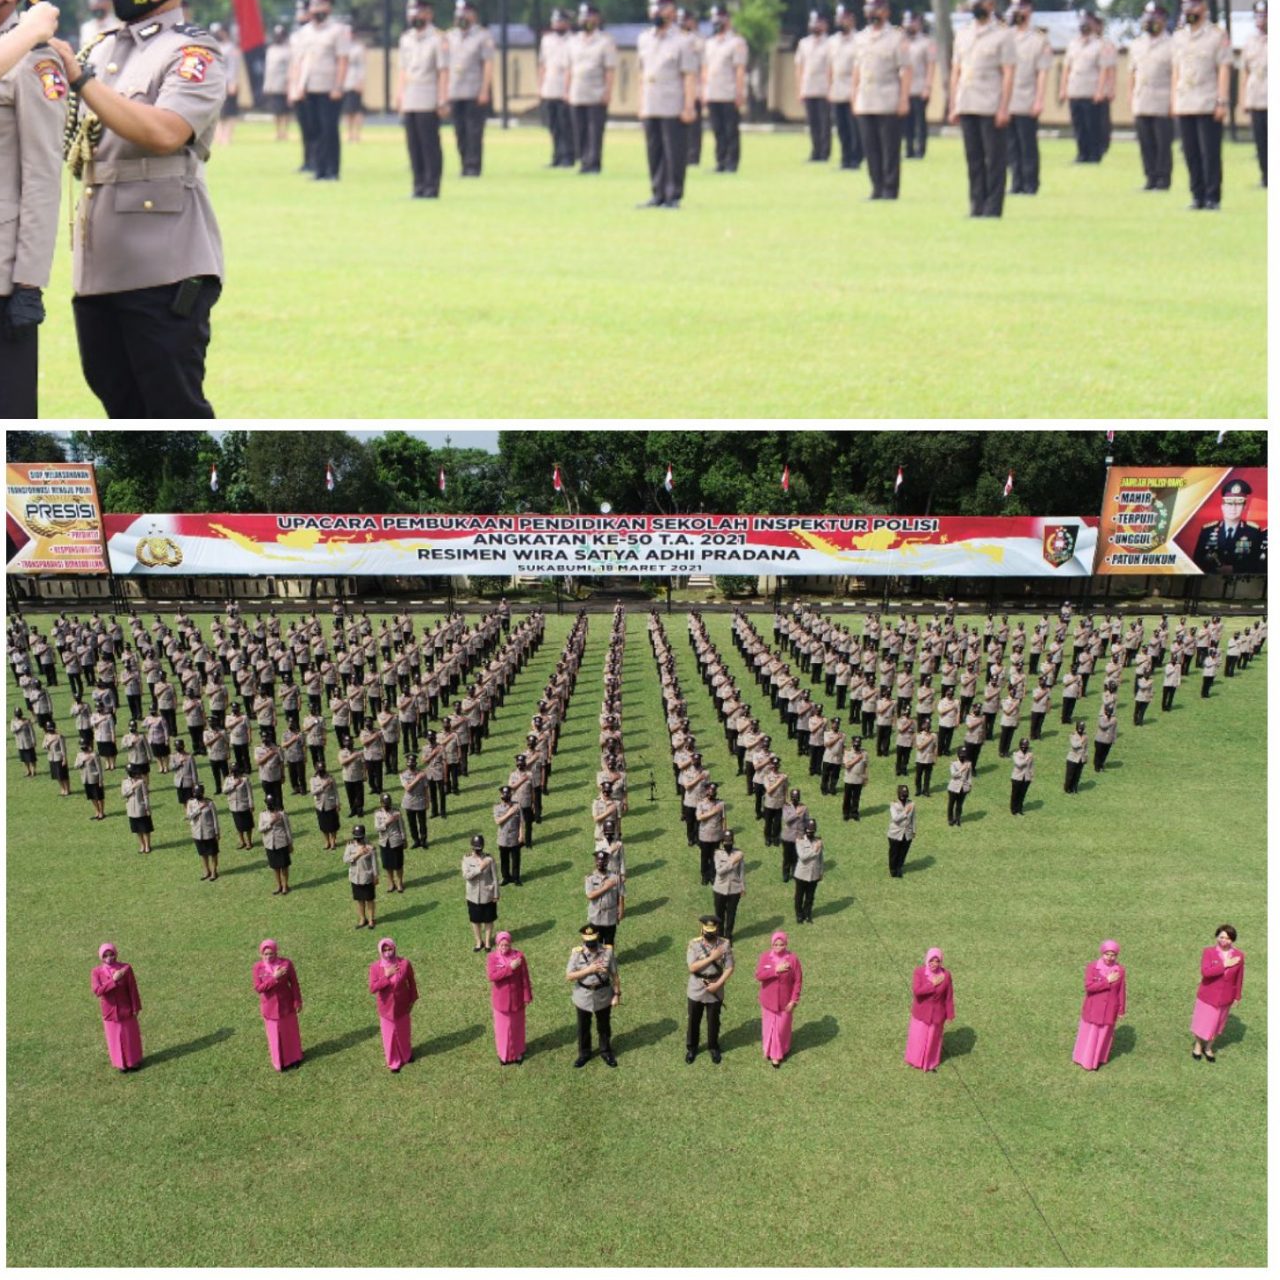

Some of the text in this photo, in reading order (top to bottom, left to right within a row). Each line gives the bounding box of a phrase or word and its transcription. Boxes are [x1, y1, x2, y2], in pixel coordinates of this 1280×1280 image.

[1121, 493, 1151, 503] MAHIR
[26, 504, 96, 518] PRESISI
[1118, 513, 1154, 524] TERPUJI
[277, 517, 939, 532] UPACARA PEMBUKAAN PENDIDIKAN SEKOLAH INSPEKTUR POLISI
[473, 533, 746, 546] ANGKATAN KE-50 T.A. 2021
[1115, 534, 1151, 544] UNGGUL
[417, 548, 801, 561] RESIMEN WIRA SATYA ADHI PRADANA
[1112, 554, 1176, 564] PATUH HUKUM
[518, 563, 595, 573] SUKABUMI,
[618, 564, 664, 572] MARET
[670, 564, 702, 572] 2021
